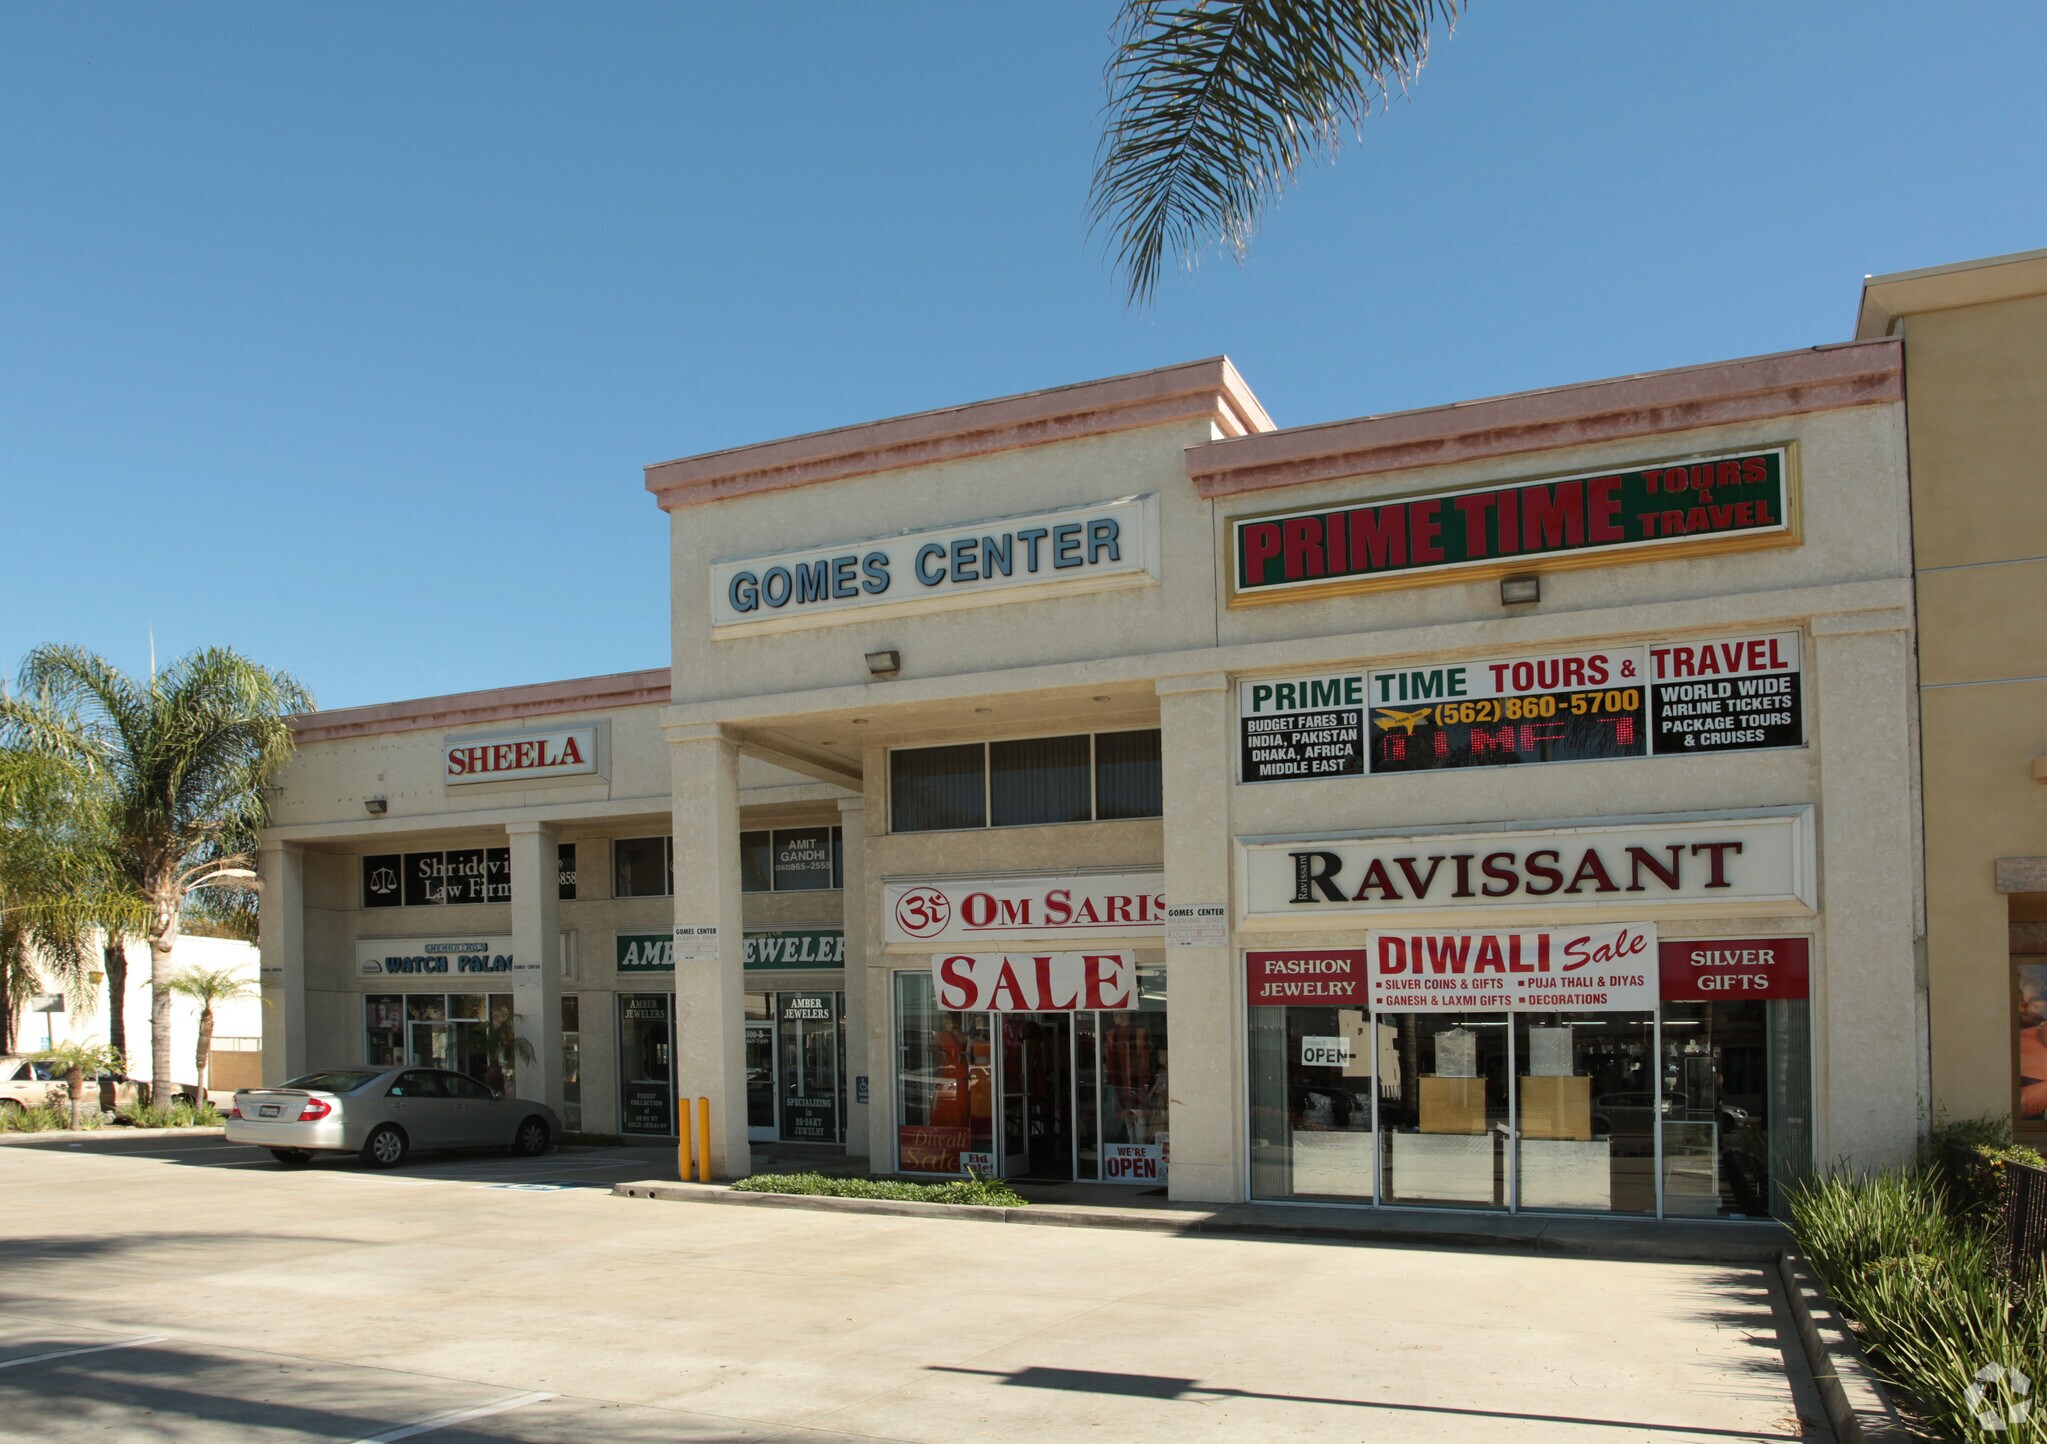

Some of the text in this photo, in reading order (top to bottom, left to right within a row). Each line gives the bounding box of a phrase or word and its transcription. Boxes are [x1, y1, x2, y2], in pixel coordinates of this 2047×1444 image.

[1641, 456, 1768, 495] TOURS
[1697, 488, 1713, 505] &
[1637, 499, 1775, 538] TRAVEL
[1243, 475, 1625, 585] PRIME TIME
[728, 517, 1121, 613] GOMES CENTER
[1252, 639, 1788, 712] PRIME TIME TOURS & TRAVEL
[1660, 677, 1791, 702] WORLD WIDE
[1435, 689, 1639, 726] (562) 860-5700
[1662, 695, 1792, 718] AIRLINE TICKETS
[1247, 712, 1357, 733] BUDGET FARES TO
[1662, 712, 1791, 734] PACKAGE TOURS
[1248, 729, 1357, 748] INDIA, PAKISTAN
[1684, 729, 1765, 747] & CRUISES
[448, 736, 585, 775] SHEELA
[1252, 743, 1353, 762] DHAKA, AFRICA
[1259, 759, 1345, 776] MIDDLE EAST
[789, 839, 816, 850] AMIT
[780, 850, 825, 861] GANDHI
[1288, 841, 1743, 904] RAVISSANT
[1298, 854, 1308, 900] Ravissant
[425, 878, 511, 899] Law Firm
[960, 892, 1033, 927] OM
[1168, 908, 1224, 917] GOMES CENTER
[1377, 928, 1648, 975] DIWALI Sale
[1690, 949, 1775, 966] SILVER
[385, 956, 448, 974] WATCH
[1264, 959, 1351, 974] FASHION
[939, 954, 1131, 1011] SALE
[1260, 981, 1356, 997] JEWELRY
[1385, 978, 1504, 990] SILVER COINS & GIFTS
[1527, 975, 1644, 989] PUJA THALI & DIYAS
[1697, 974, 1769, 990] GIFTS
[630, 1000, 657, 1008] AMBER
[791, 998, 822, 1008] AMBER
[1386, 995, 1512, 1006] GANESH & LAXMI GIFTS
[1528, 993, 1608, 1005] DECORATIONS
[625, 1009, 665, 1019] JEWELERS
[784, 1008, 829, 1019] JEWELERS
[1303, 1048, 1348, 1063] OPEN
[786, 1097, 831, 1107] SPECIALIZING
[794, 1127, 824, 1136] JEWELRY
[914, 1129, 967, 1148] Diwali
[904, 1148, 960, 1171] Sale
[1117, 1147, 1147, 1157] WE'RE
[1107, 1157, 1156, 1178] OPEN
